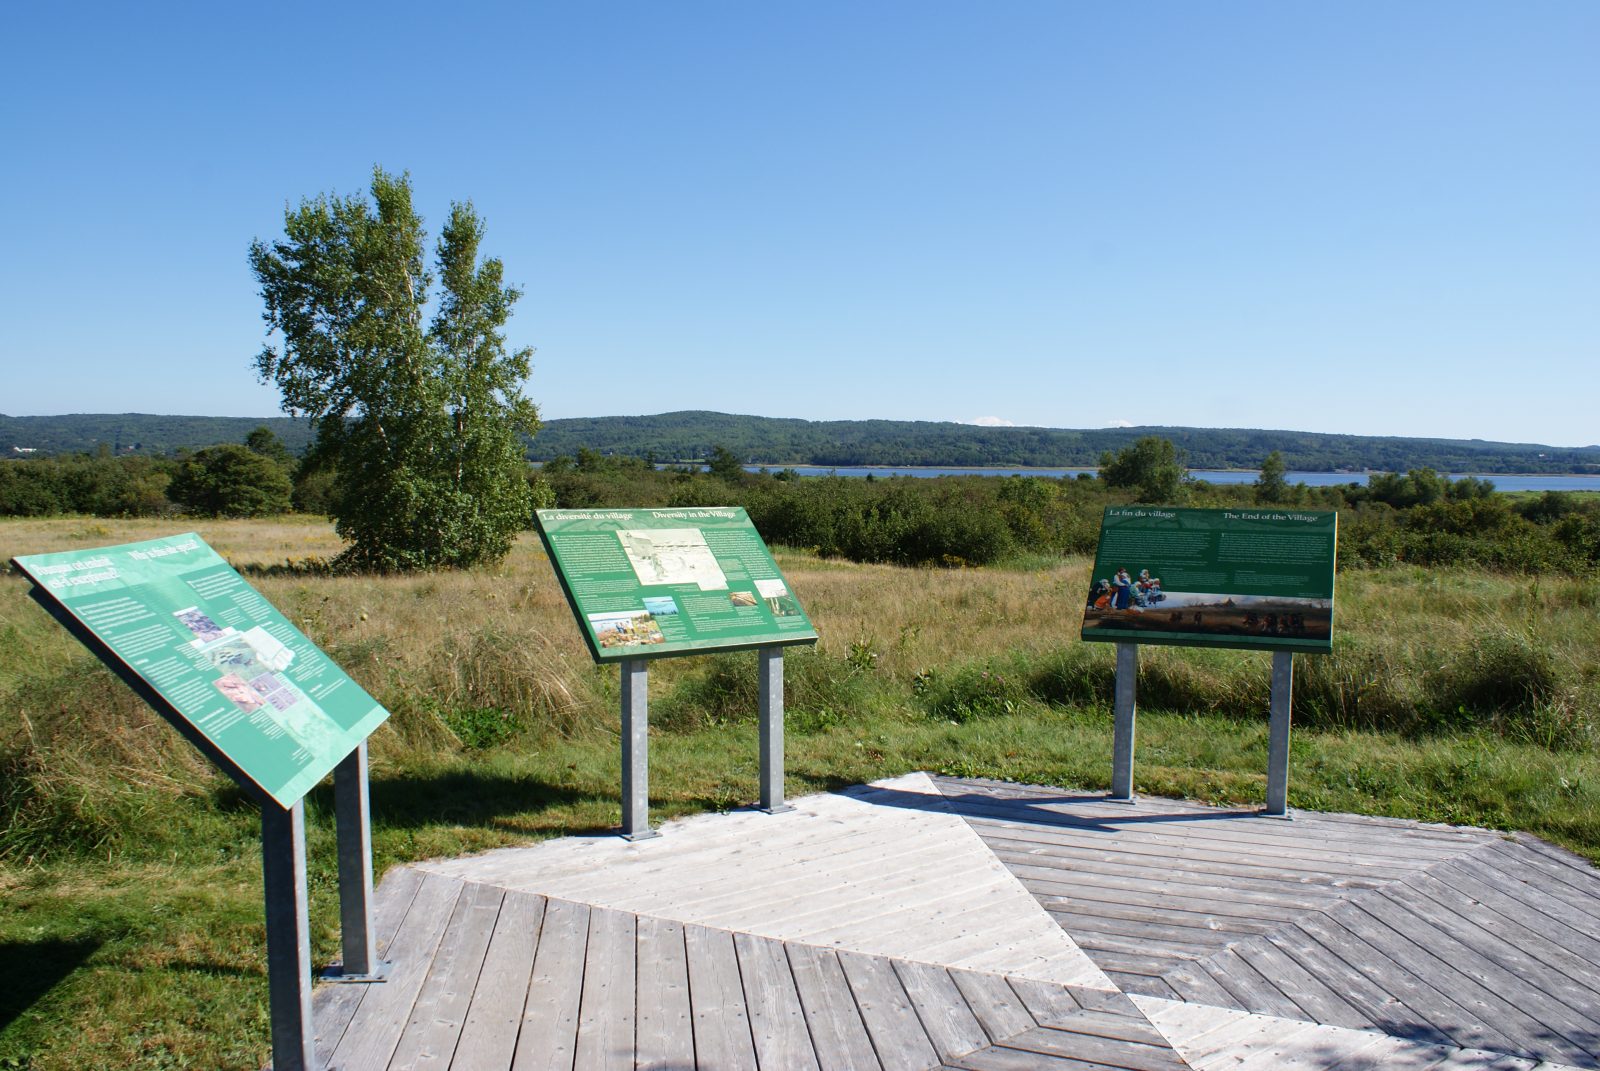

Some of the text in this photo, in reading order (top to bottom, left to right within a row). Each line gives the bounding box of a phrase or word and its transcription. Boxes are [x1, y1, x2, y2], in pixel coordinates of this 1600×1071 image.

[593, 512, 604, 520] du
[606, 512, 633, 521] village
[652, 511, 688, 520] Diversity
[709, 510, 736, 519] Village
[1148, 510, 1176, 518] village
[1288, 514, 1318, 522] Village
